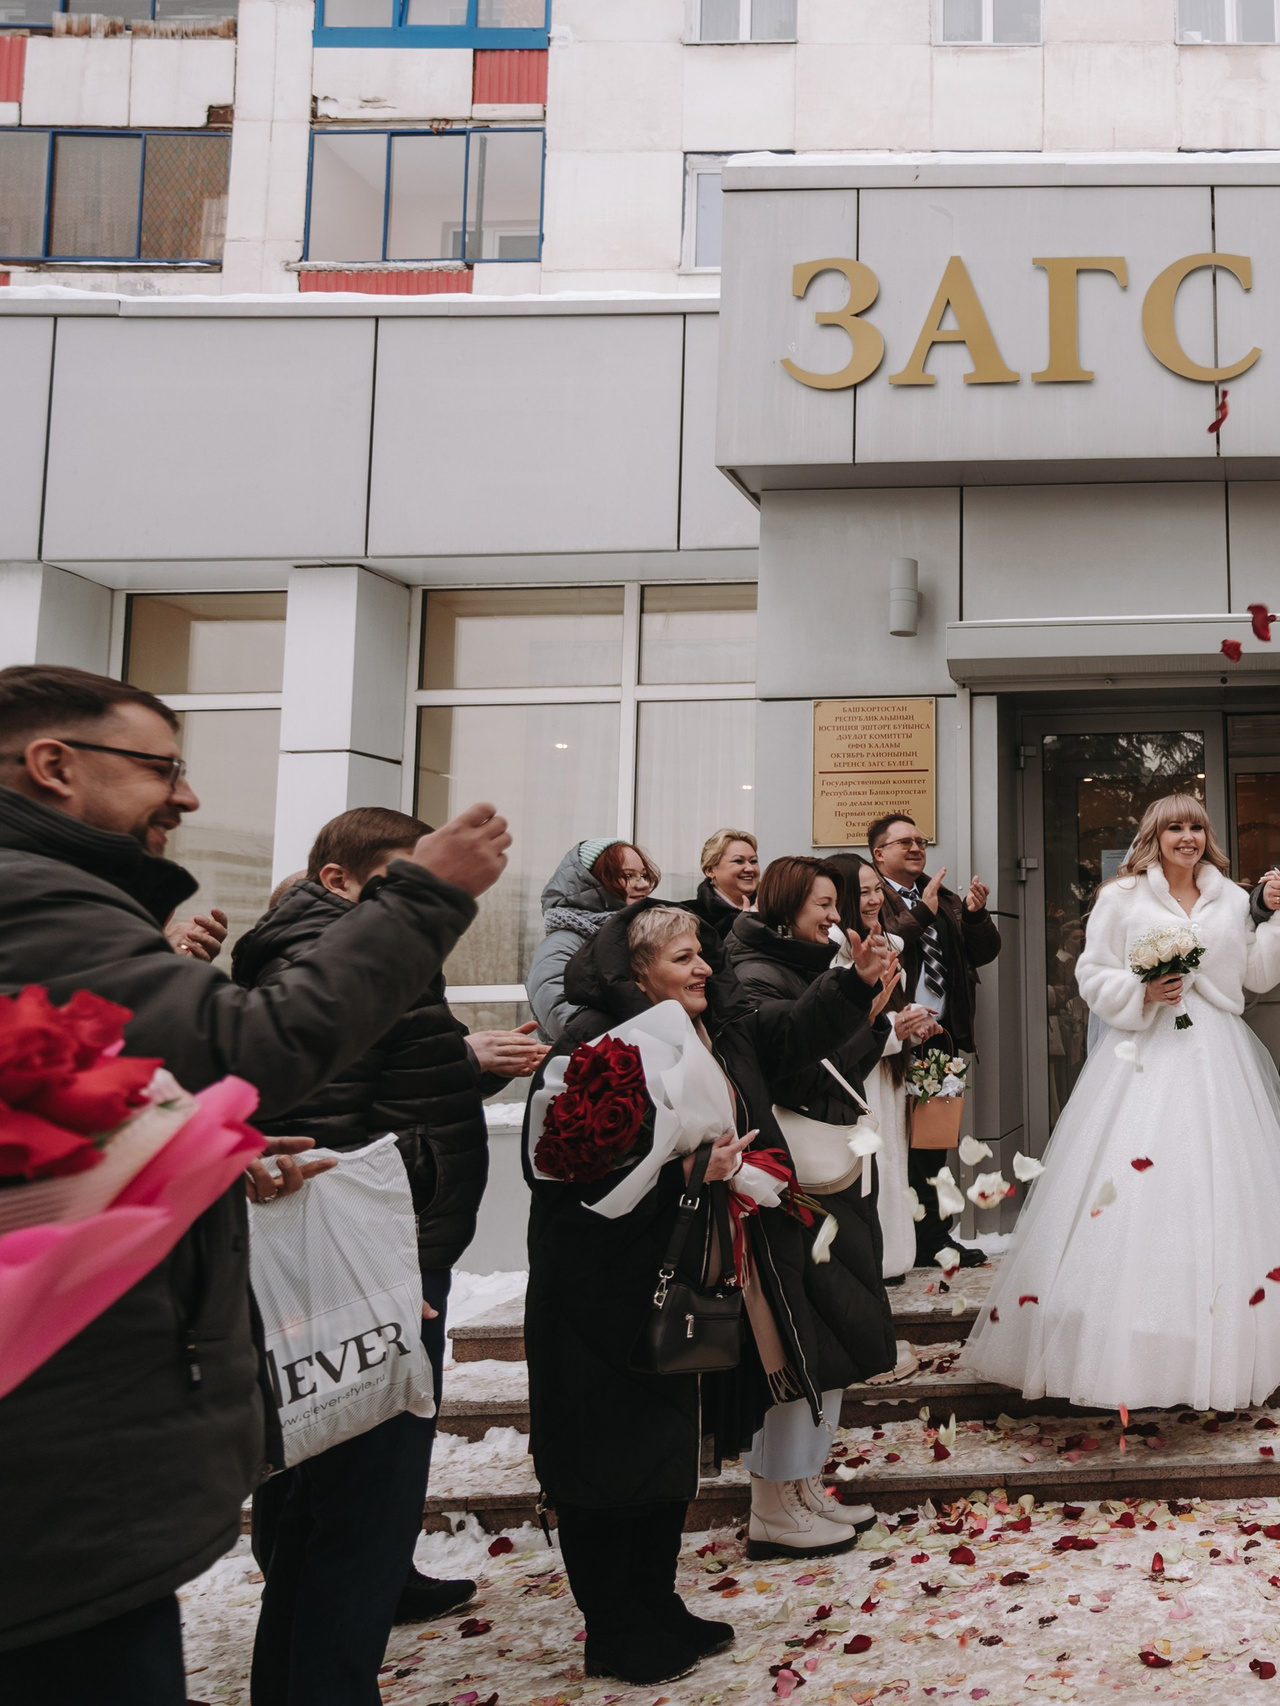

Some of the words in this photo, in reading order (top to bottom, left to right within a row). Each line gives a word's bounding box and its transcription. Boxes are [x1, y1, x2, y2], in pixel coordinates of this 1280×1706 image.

[779, 252, 1262, 389] ЗАГС
[869, 732, 913, 740] КОМИТЕТЫ
[821, 779, 891, 788] Государственный
[820, 789, 868, 798] Республики
[869, 788, 927, 797] Башкортостан
[834, 810, 866, 819] Первый
